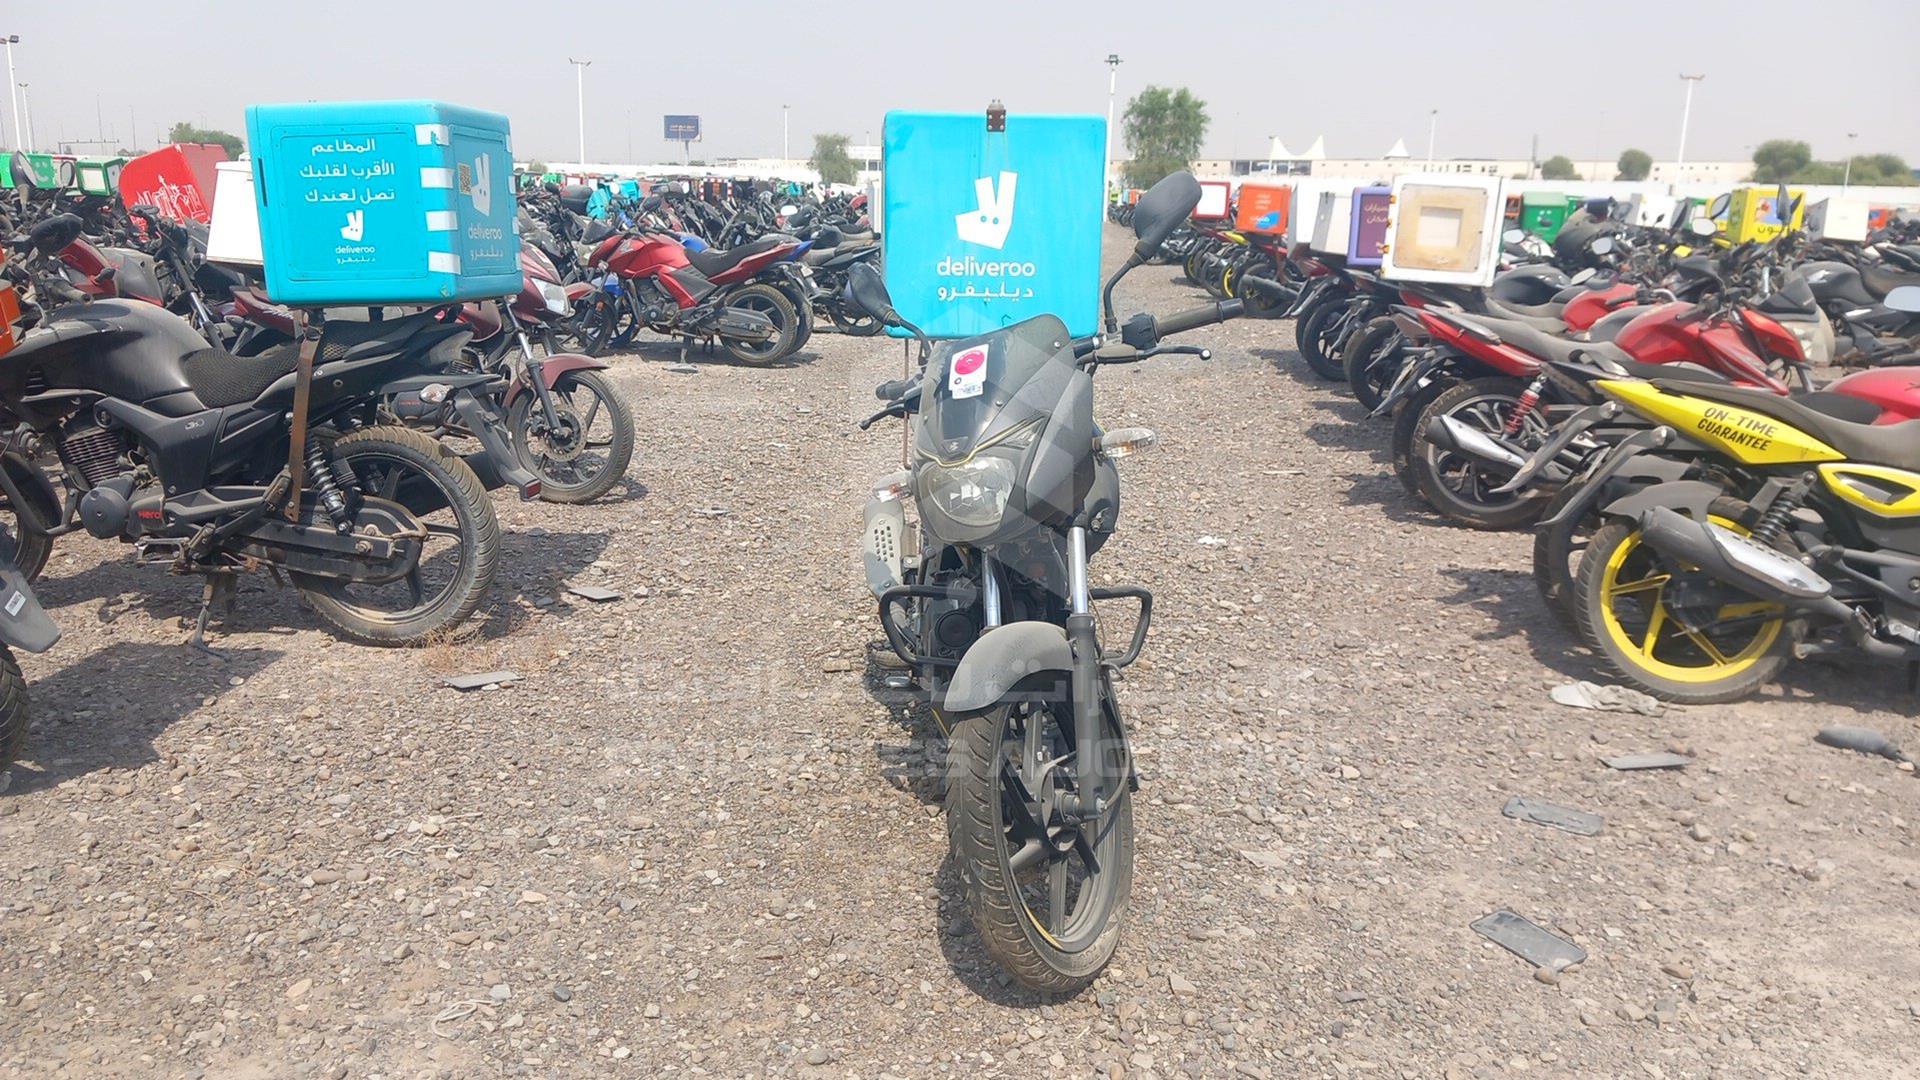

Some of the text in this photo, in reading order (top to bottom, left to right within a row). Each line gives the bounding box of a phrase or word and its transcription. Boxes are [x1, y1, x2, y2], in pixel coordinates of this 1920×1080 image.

[312, 138, 375, 156] المطاعم
[300, 159, 395, 180] الأقرب لقلبك
[305, 188, 395, 204] تصل لعندك
[468, 223, 502, 240] deliveroo
[335, 245, 376, 254] deliveroo
[937, 255, 1036, 277] deliveroo
[937, 281, 1034, 302] ديليفرو
[1704, 407, 1778, 438] ON-TIME
[1697, 418, 1772, 451] GUARANTEE
